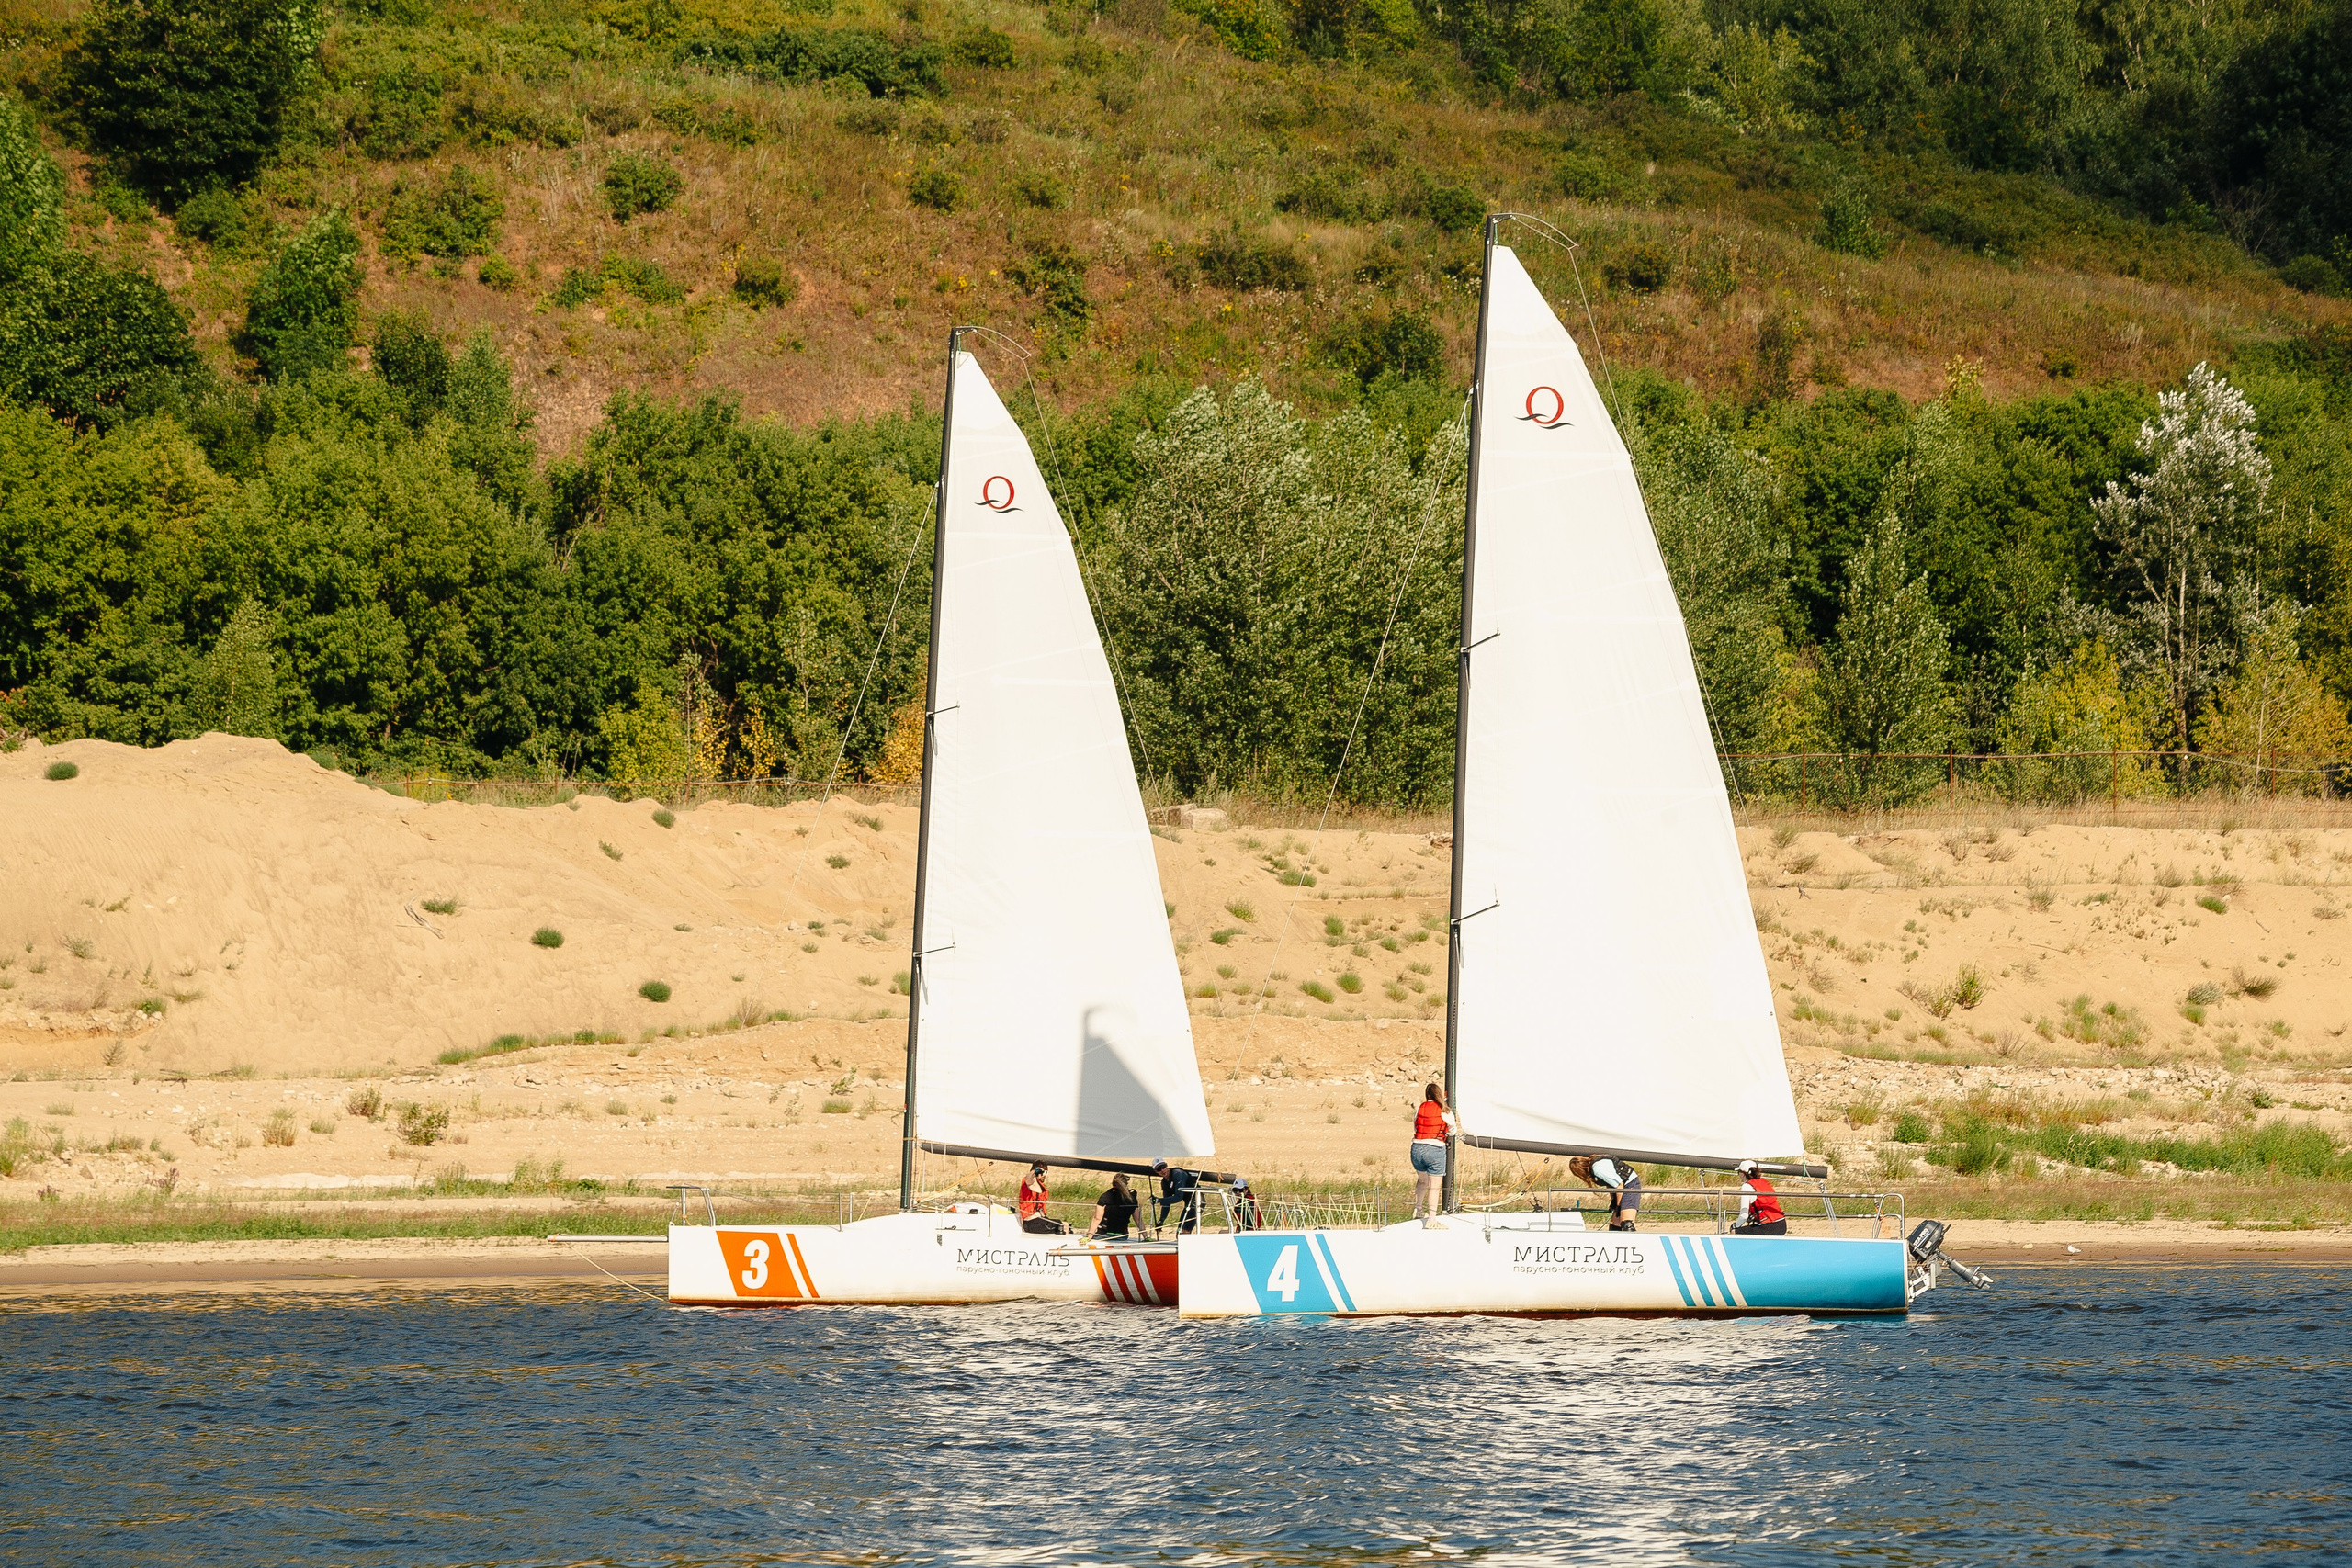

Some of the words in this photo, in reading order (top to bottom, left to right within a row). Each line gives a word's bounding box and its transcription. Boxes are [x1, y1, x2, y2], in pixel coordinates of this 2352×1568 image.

[957, 1248, 1070, 1267] МИСТРАЛЬ
[1513, 1246, 1645, 1264] МИСТРАЛЬ
[741, 1239, 770, 1290] 3
[956, 1265, 1046, 1275] парусно-гоночный
[1047, 1268, 1070, 1277] клуб
[1266, 1244, 1300, 1302] 4
[1512, 1265, 1616, 1275] парусно-гоночный
[1619, 1265, 1645, 1276] клуб
